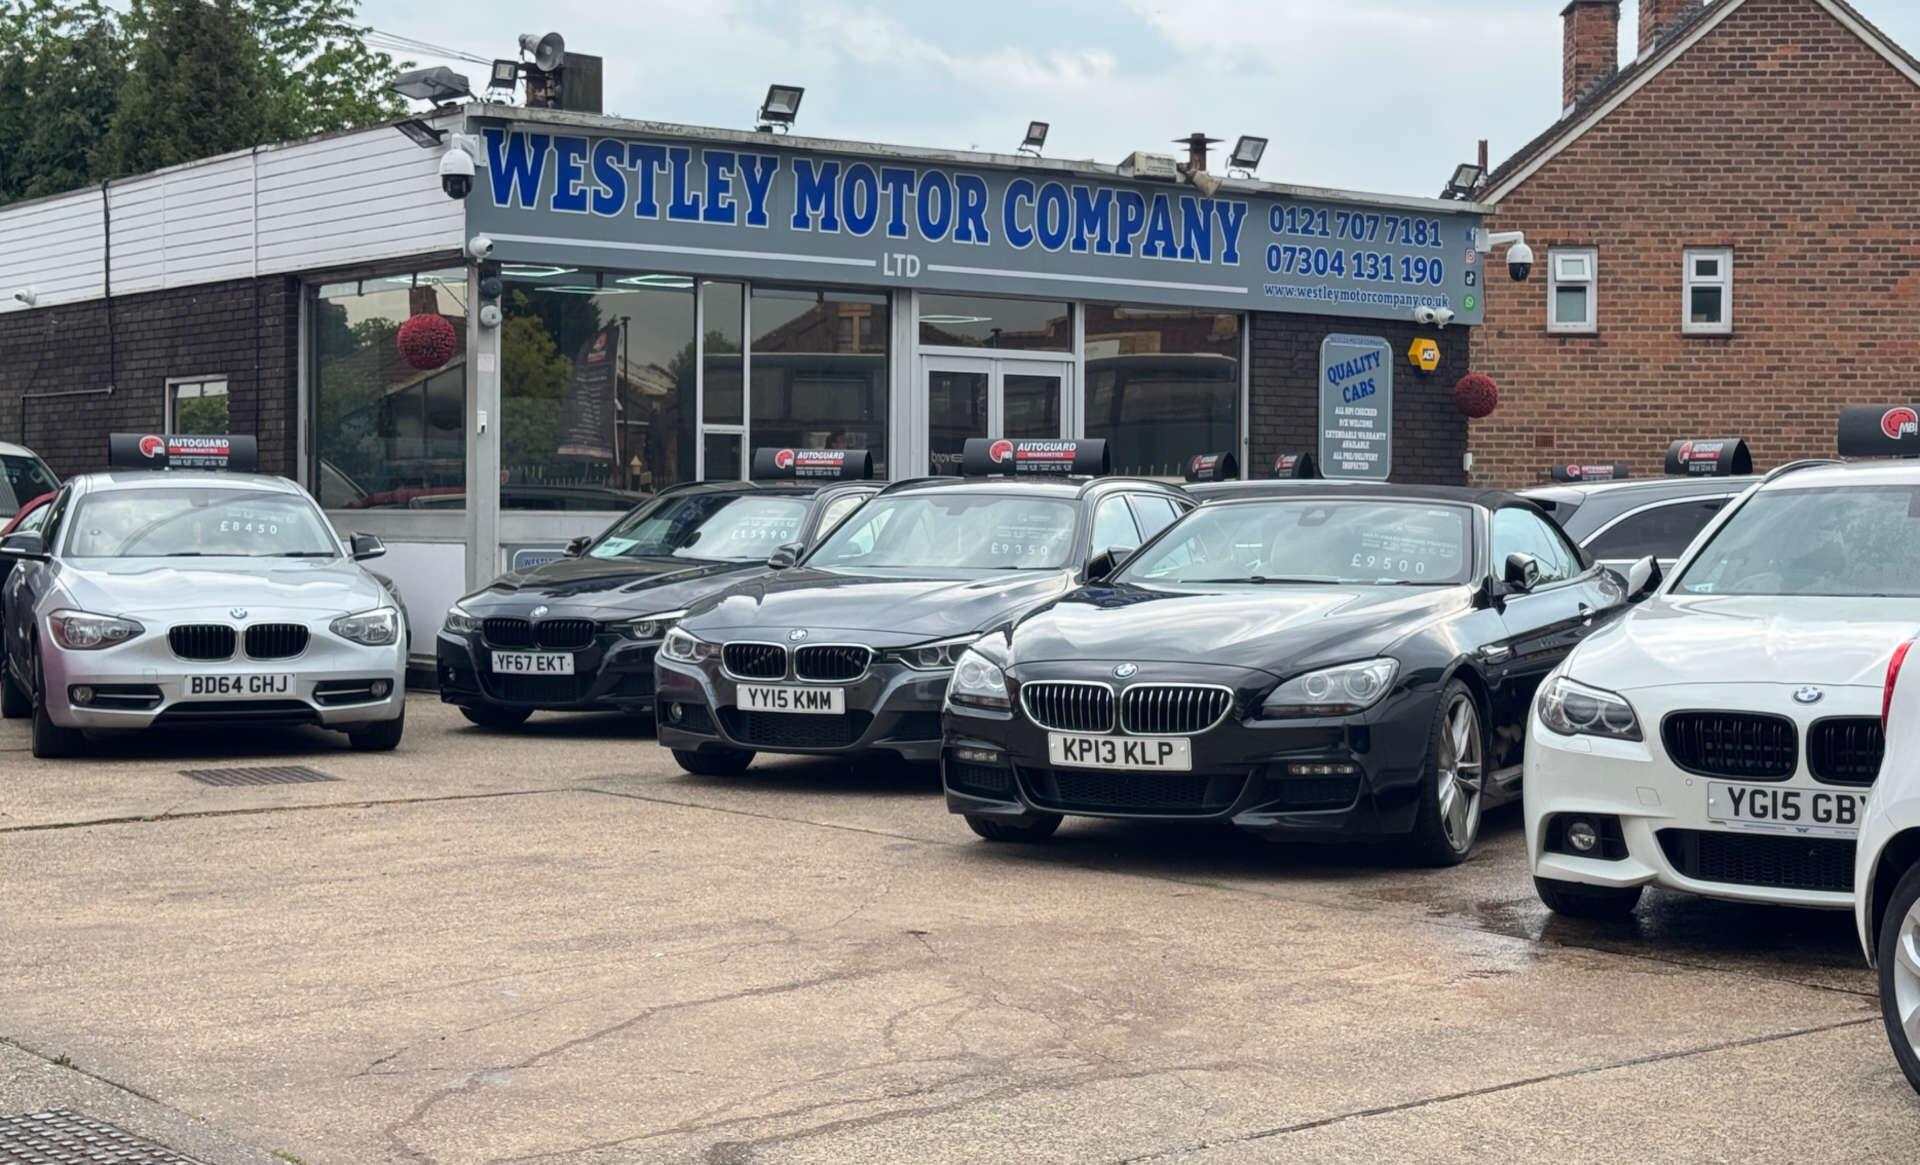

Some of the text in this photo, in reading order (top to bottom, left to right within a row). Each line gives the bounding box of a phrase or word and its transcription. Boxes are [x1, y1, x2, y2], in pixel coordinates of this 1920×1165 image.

[481, 127, 1248, 266] WESTLEY MOTOR COMPANY
[1269, 205, 1442, 248] 0121 707 7181
[884, 253, 920, 278] LTD
[1266, 244, 1443, 286] 07304 131 190
[1264, 284, 1449, 308] www.westleymotorcompany.co.uk
[1327, 351, 1381, 387] QUALITY
[1342, 378, 1376, 404] CARS
[168, 438, 229, 448] AUTOGUARD
[1017, 442, 1077, 452] AUTOGUARD
[798, 451, 845, 460] AUTOGUARD
[220, 520, 278, 535] £8450
[1351, 553, 1425, 574] £9500
[497, 654, 565, 671] YF67 EKT
[191, 675, 287, 694] BD64 GHJ
[748, 688, 831, 709] YY15 KMM
[1063, 738, 1173, 765] KP13 KLP
[1728, 787, 1801, 821] YG15
